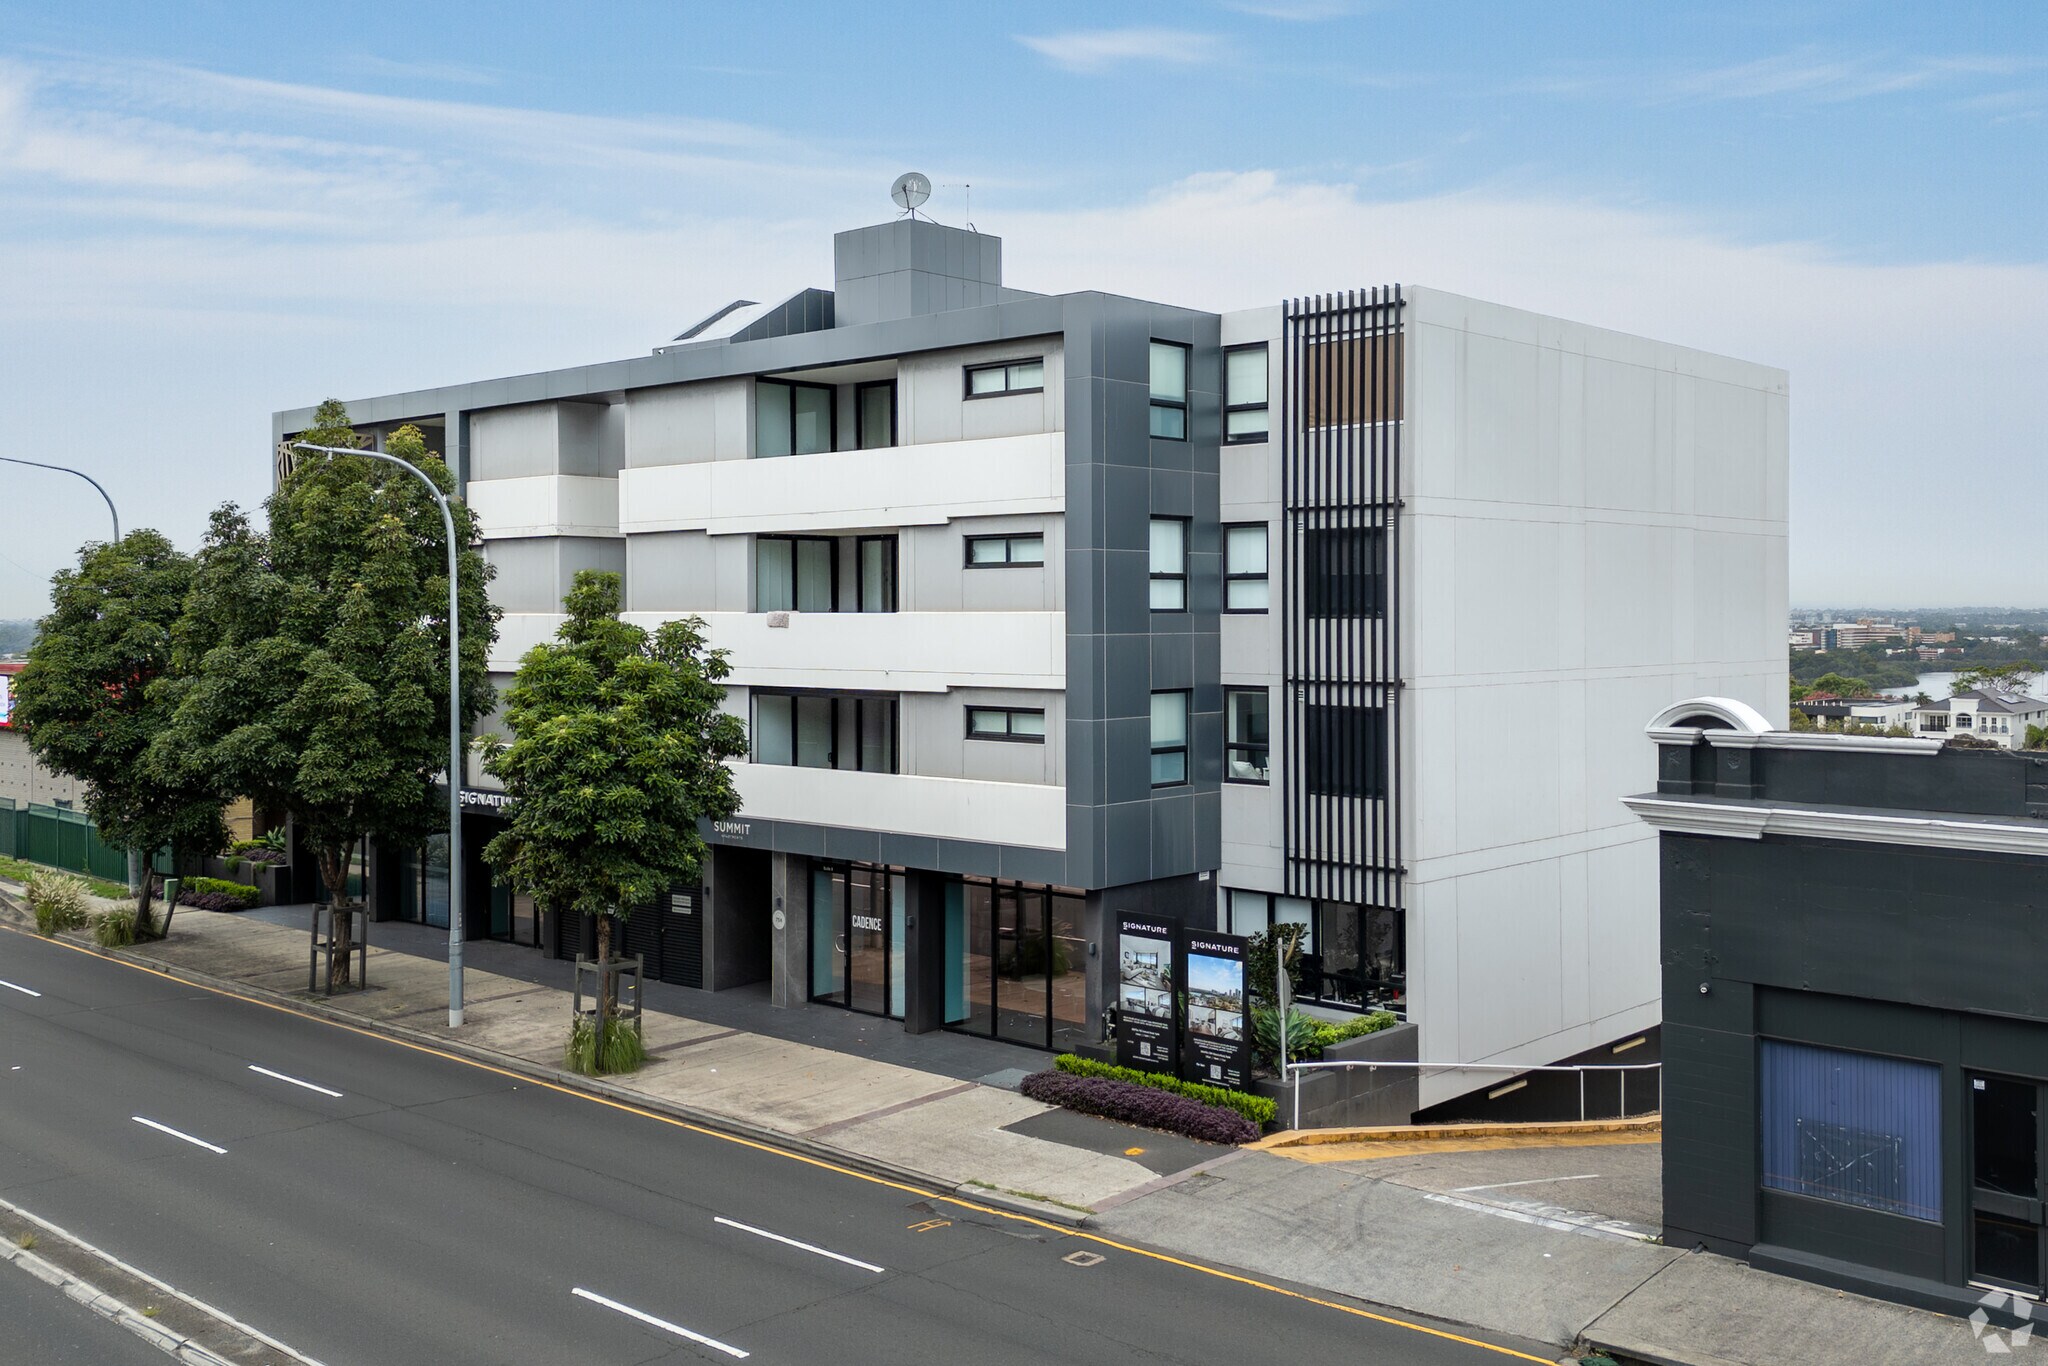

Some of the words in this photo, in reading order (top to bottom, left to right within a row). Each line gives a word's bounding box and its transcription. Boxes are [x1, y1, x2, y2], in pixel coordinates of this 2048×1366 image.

[459, 790, 521, 808] SIGNATU
[713, 820, 751, 835] SUMMIT
[852, 914, 882, 931] CADENCE
[1123, 921, 1168, 935] SIGNATURE
[1191, 940, 1240, 955] SIGNATURE
